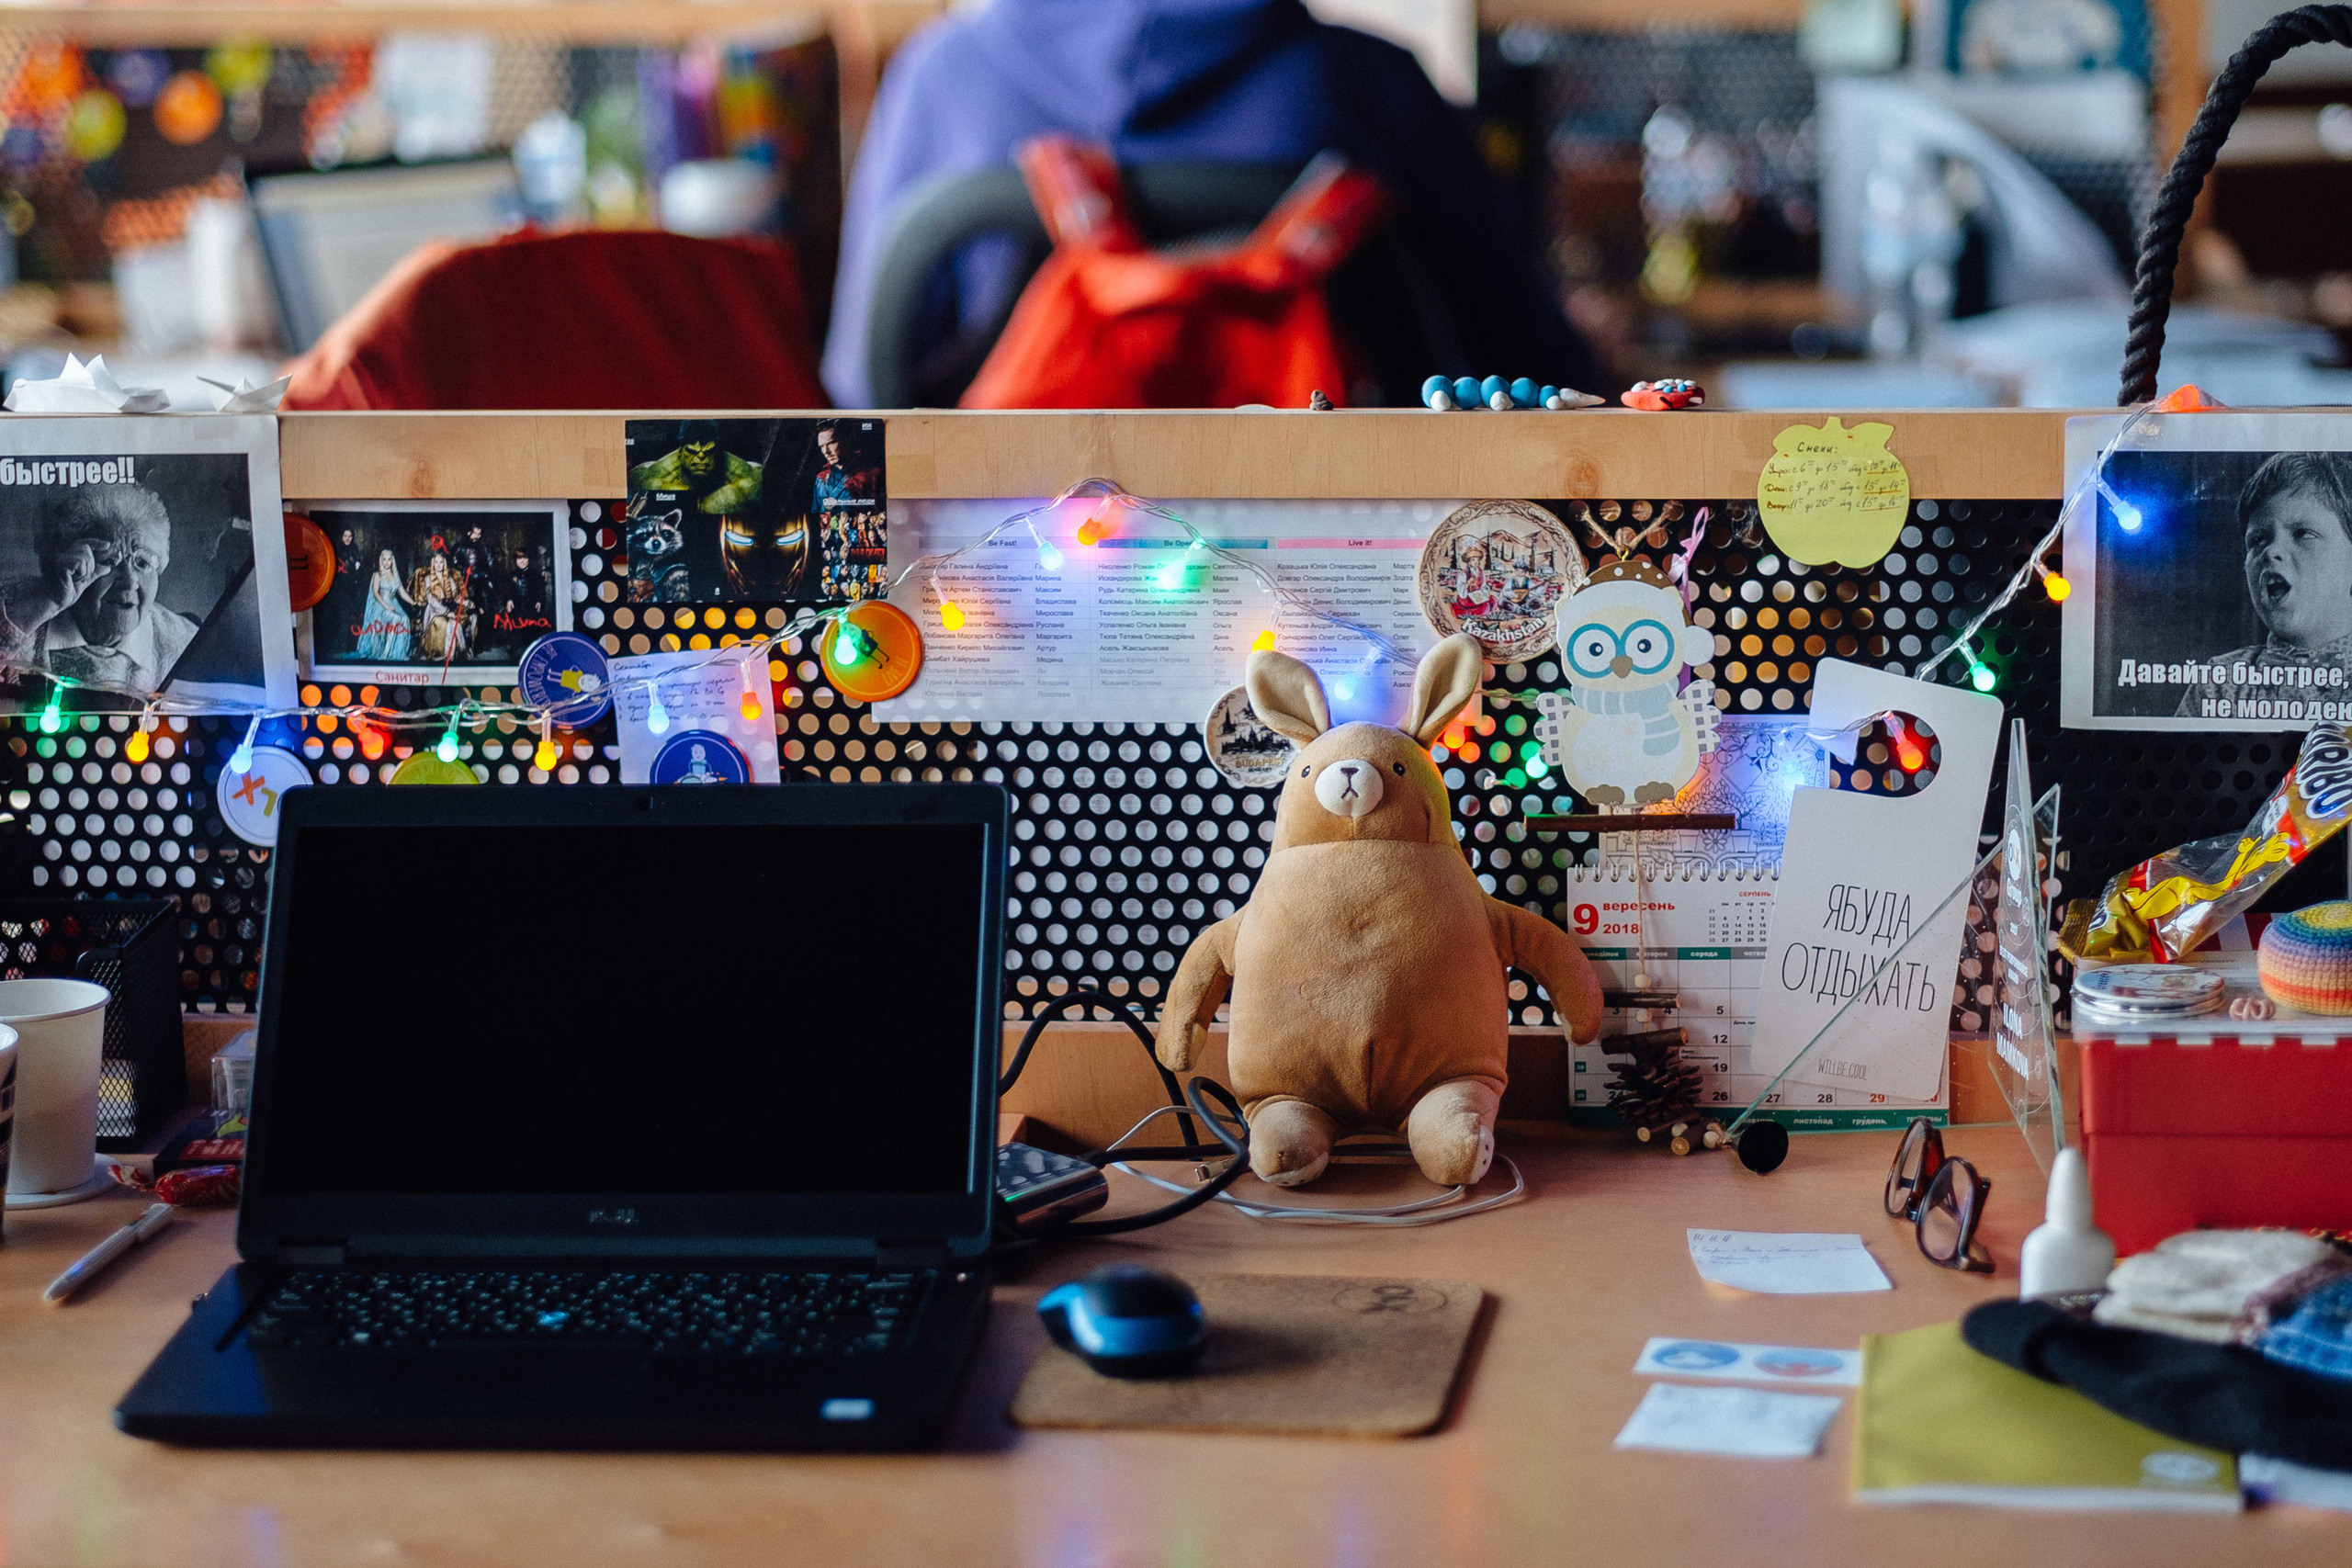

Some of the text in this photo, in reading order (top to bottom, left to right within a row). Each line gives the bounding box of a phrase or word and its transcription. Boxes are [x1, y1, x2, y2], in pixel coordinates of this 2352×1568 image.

[0, 457, 136, 488] быстрее!!
[1462, 617, 1544, 643] Kazakhstan
[376, 671, 429, 685] Санитар
[2118, 659, 2349, 689] Давайте быстрее,
[2201, 698, 2232, 718] не
[1603, 902, 1675, 913] вересень
[1573, 904, 1599, 935] 9
[1602, 924, 1639, 934] 2018
[1690, 950, 1718, 958] середа
[1782, 942, 1936, 1012] ОТДЫХАТЬ
[1716, 1006, 1724, 1015] 5
[1713, 1034, 1727, 1043] 12
[1713, 1063, 1727, 1072] 19
[1712, 1091, 1728, 1100] 26
[1766, 1094, 1781, 1103] 27
[1817, 1094, 1833, 1103] 28
[1870, 1094, 1885, 1102] 29
